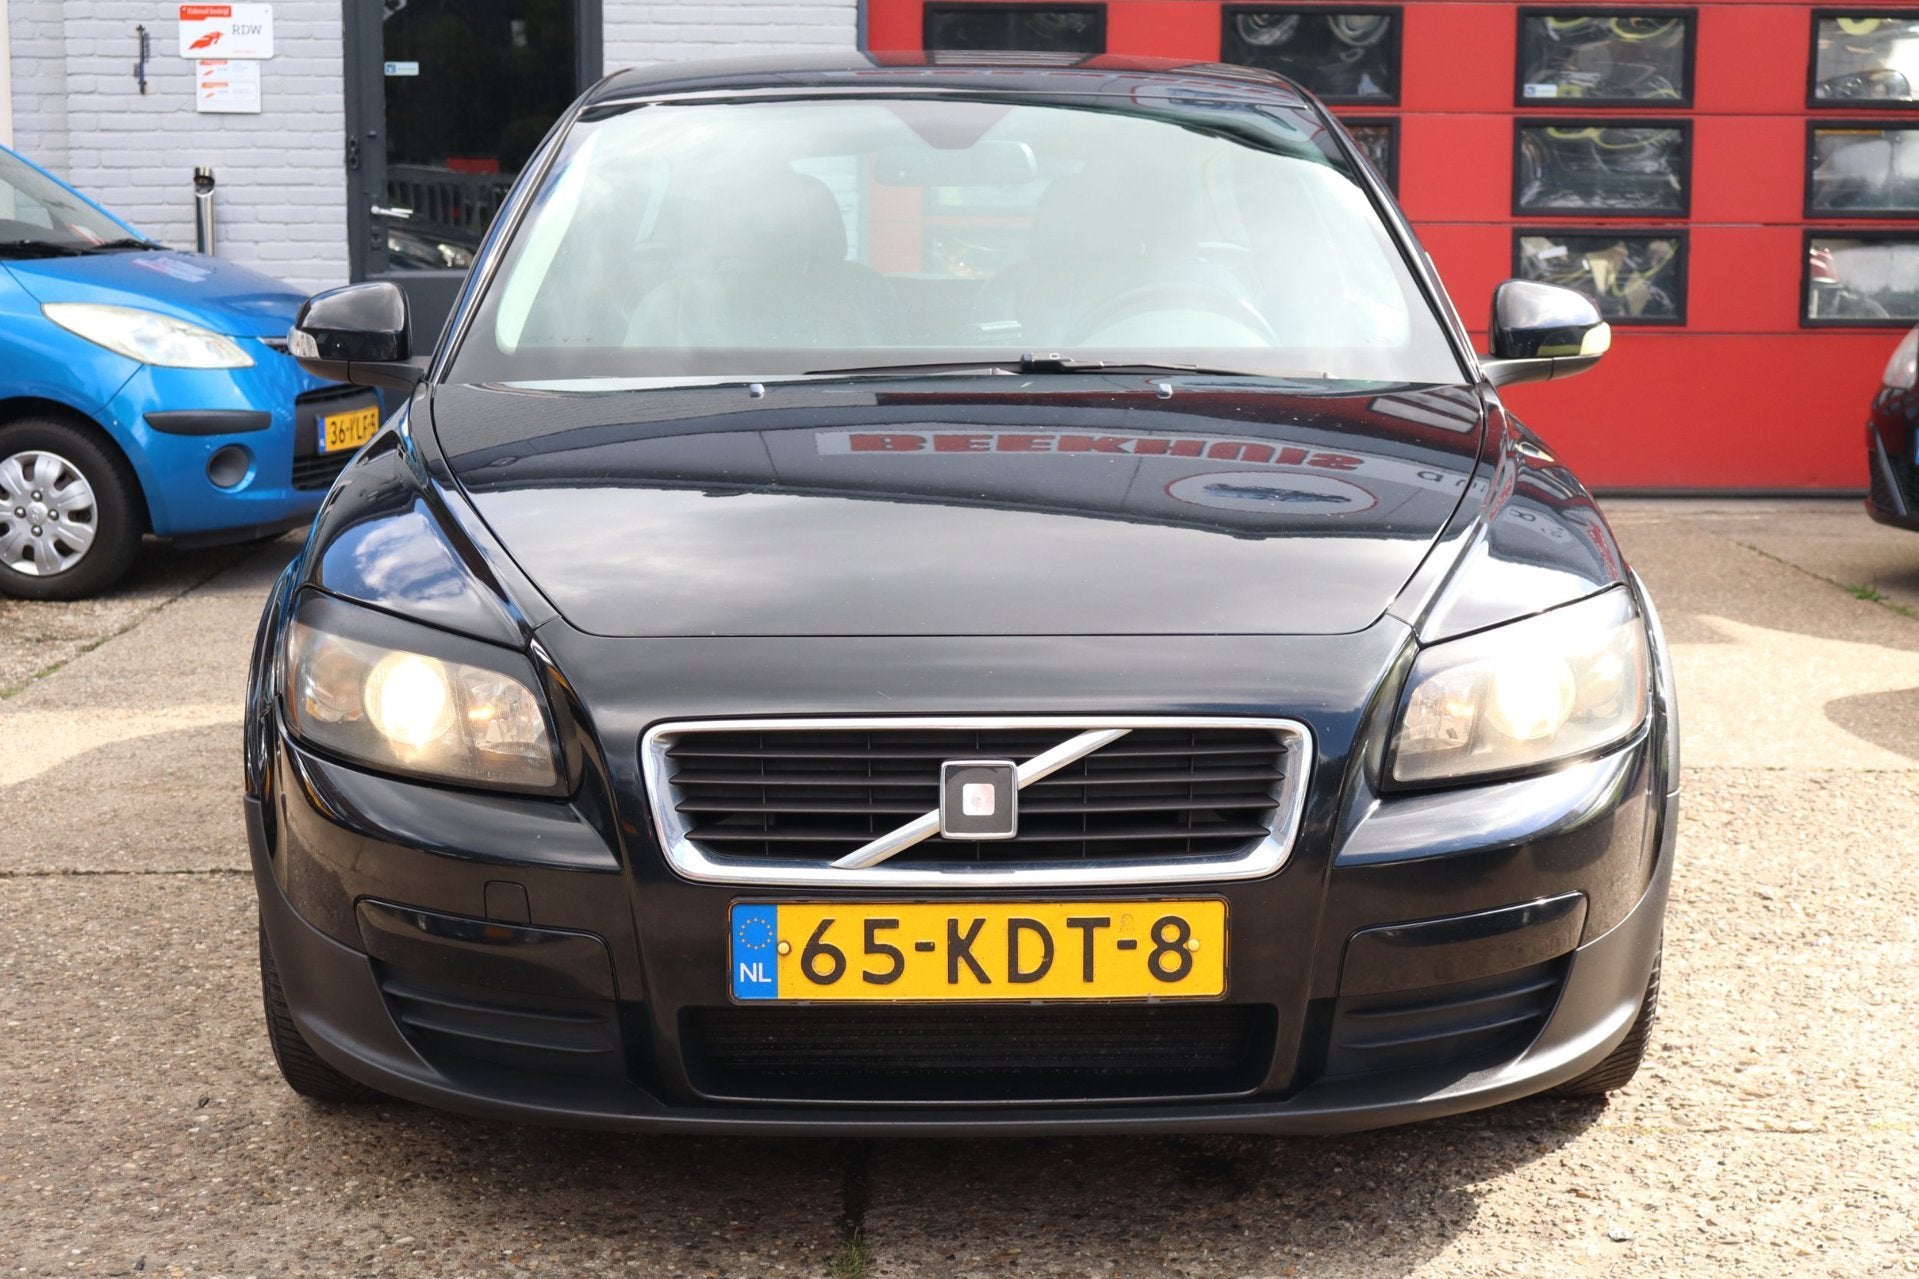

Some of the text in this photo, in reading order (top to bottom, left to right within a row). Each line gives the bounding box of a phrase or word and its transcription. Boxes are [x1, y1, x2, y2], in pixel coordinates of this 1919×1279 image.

[232, 24, 262, 36] RDW
[800, 915, 1194, 985] 65-KDT-8
[740, 962, 772, 983] NL
